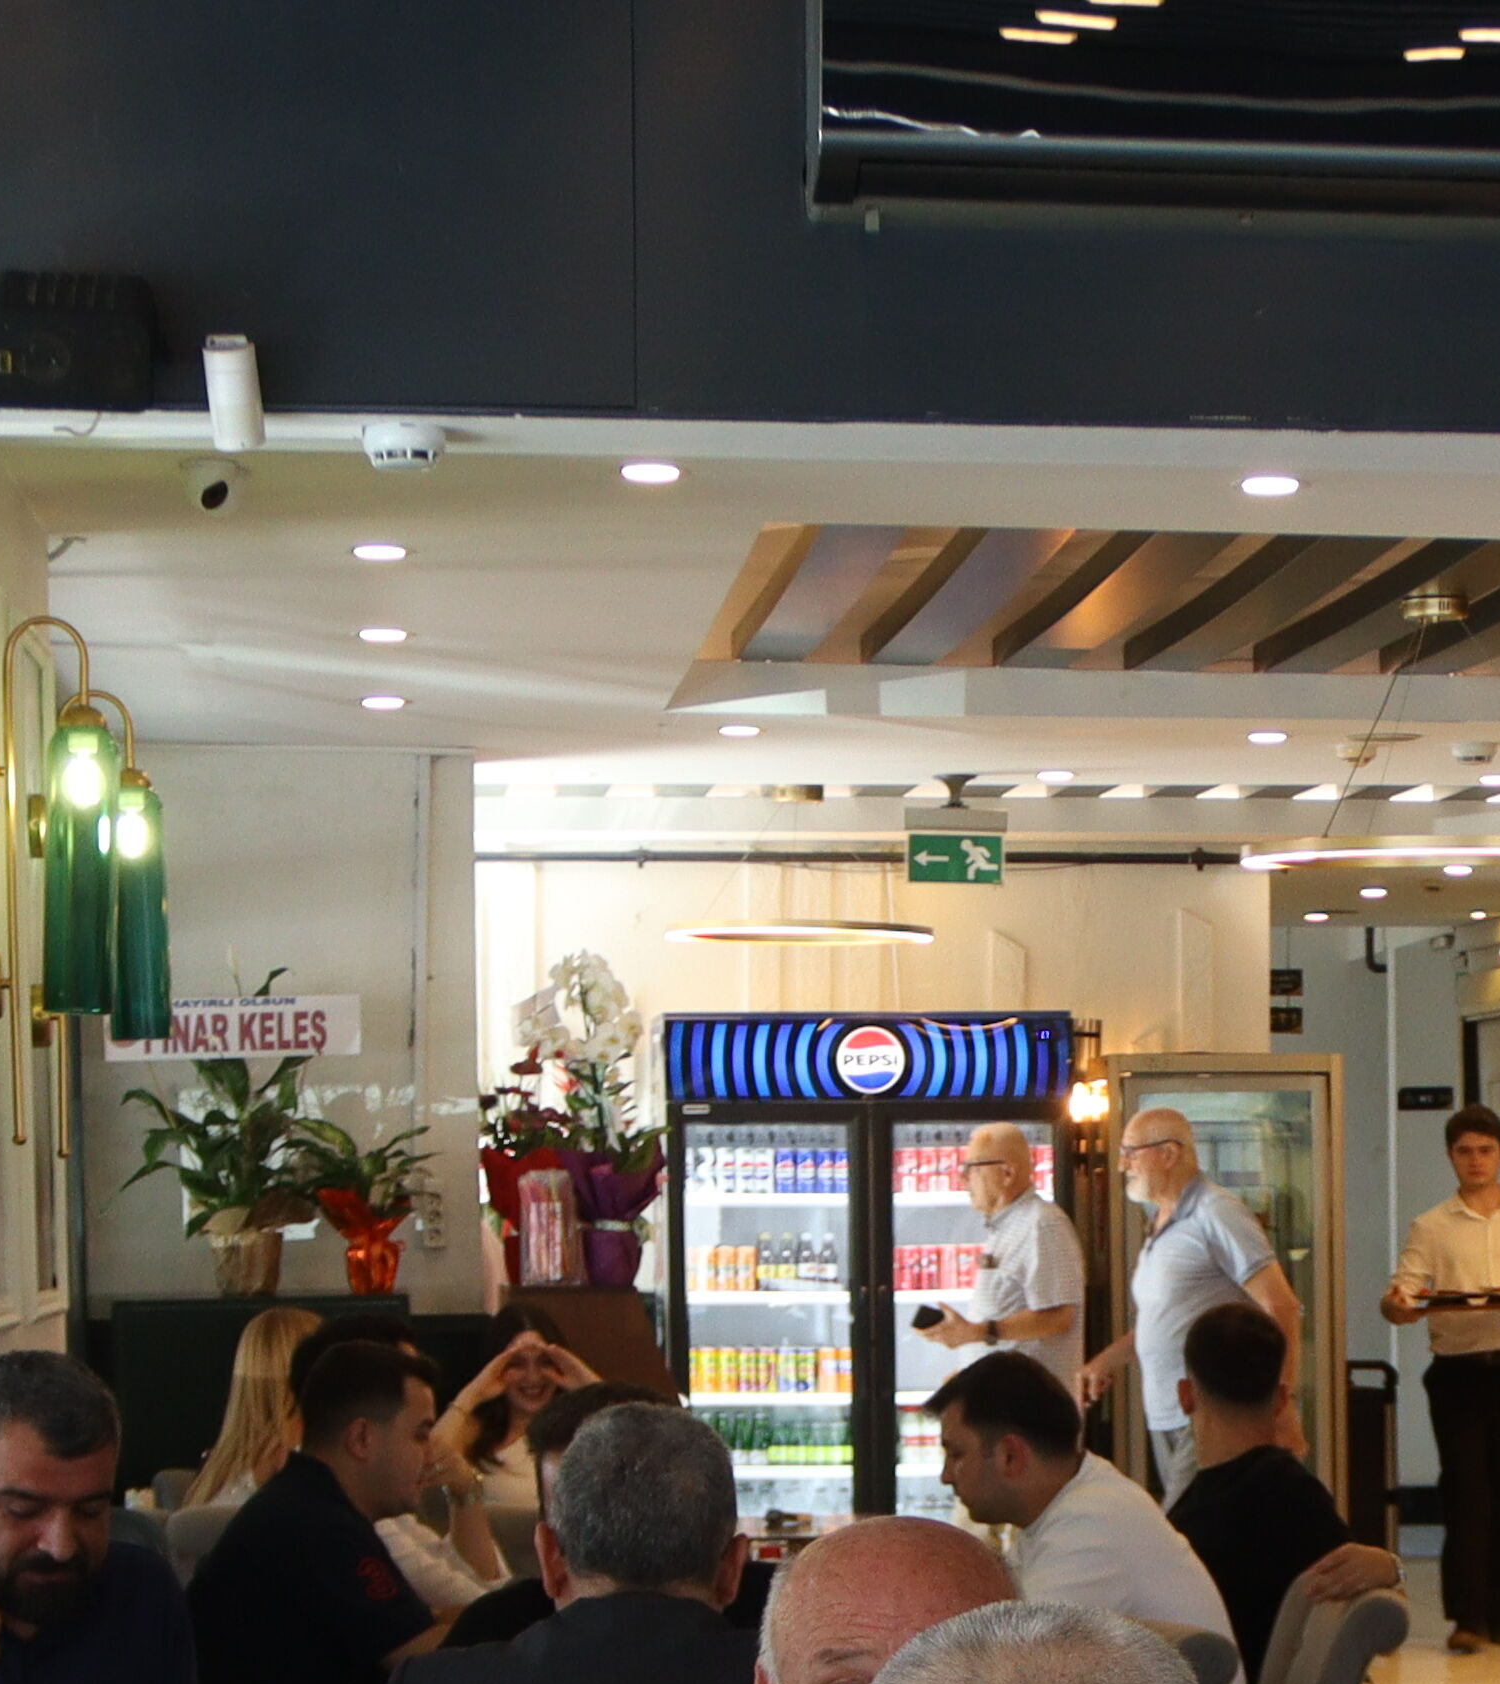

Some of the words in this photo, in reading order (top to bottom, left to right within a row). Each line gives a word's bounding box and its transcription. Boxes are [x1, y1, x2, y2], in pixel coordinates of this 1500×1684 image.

[144, 1013, 229, 1054] NAR
[239, 1010, 327, 1056] KELEŞ
[843, 1054, 898, 1067] PEPSI
